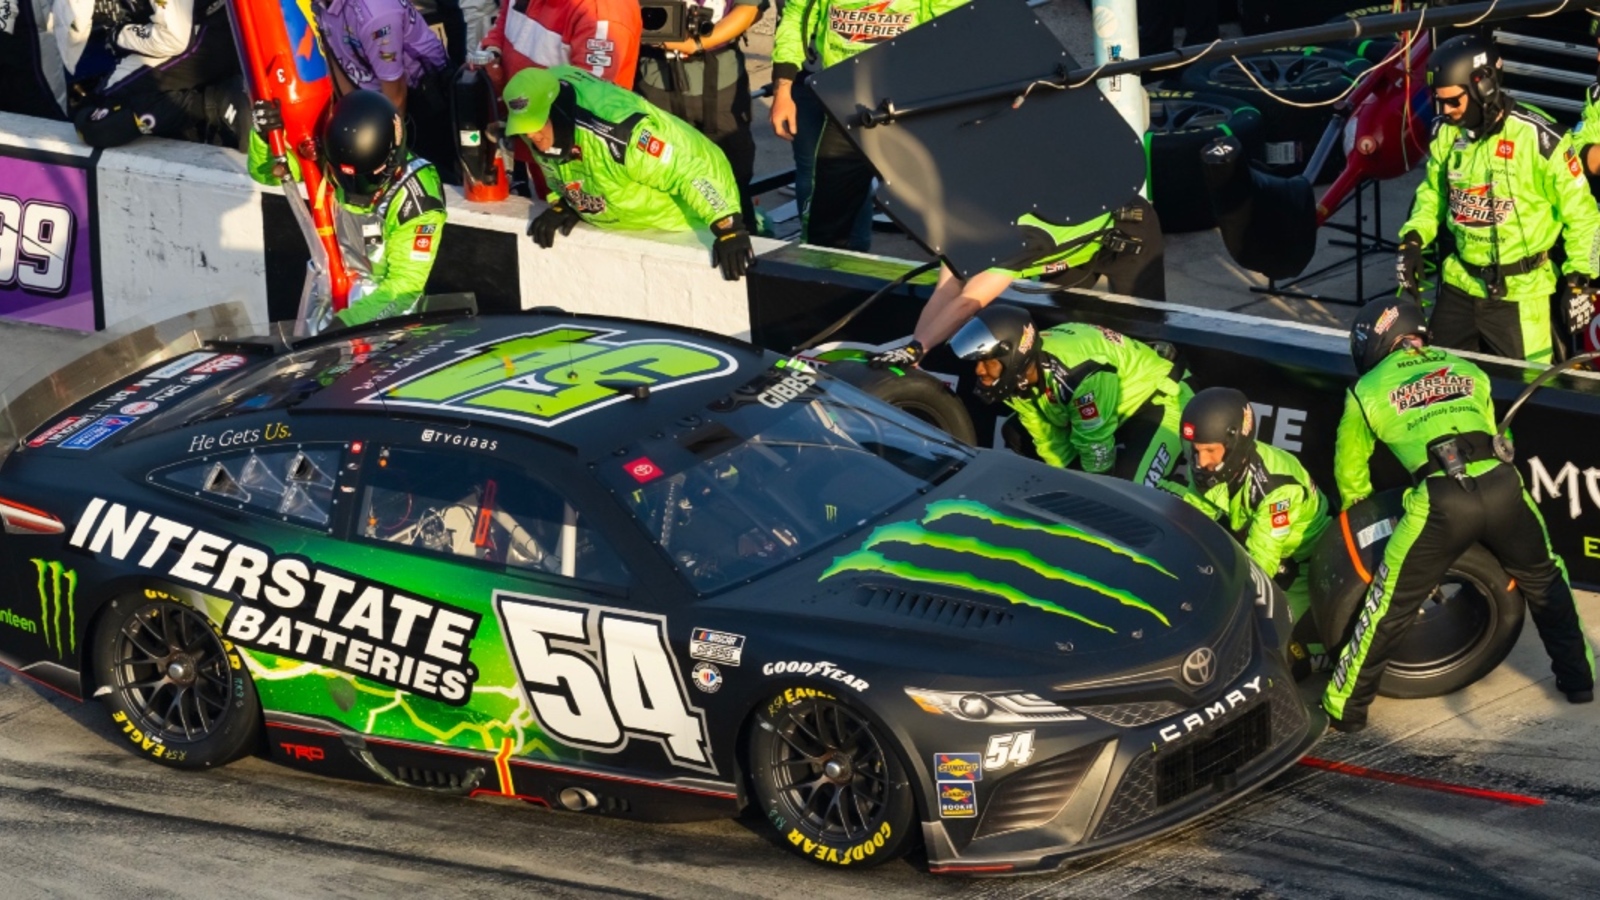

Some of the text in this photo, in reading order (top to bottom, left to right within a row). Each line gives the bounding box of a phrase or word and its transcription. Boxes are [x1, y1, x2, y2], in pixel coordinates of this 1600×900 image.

[830, 7, 912, 24] INTERSTATE
[831, 20, 906, 36] BATTERIES
[1472, 51, 1488, 69] 54
[757, 369, 817, 409] GIBBS
[1390, 375, 1474, 401] INTERSTATE
[1399, 385, 1473, 411] BATTERIES
[187, 421, 292, 453] He Gets Us.
[69, 496, 475, 665] INTERSTATE
[226, 604, 469, 700] BATTERIES
[496, 596, 714, 770] 54
[762, 660, 871, 692] GOODYEAR
[1159, 675, 1262, 743] CAMRY
[112, 710, 166, 758] EAGLE
[279, 742, 325, 762] TRD
[983, 730, 1035, 771] 54
[938, 762, 979, 774] SUNOCO
[941, 803, 974, 811] ROOKIE
[787, 821, 892, 865] GOODYEAR
